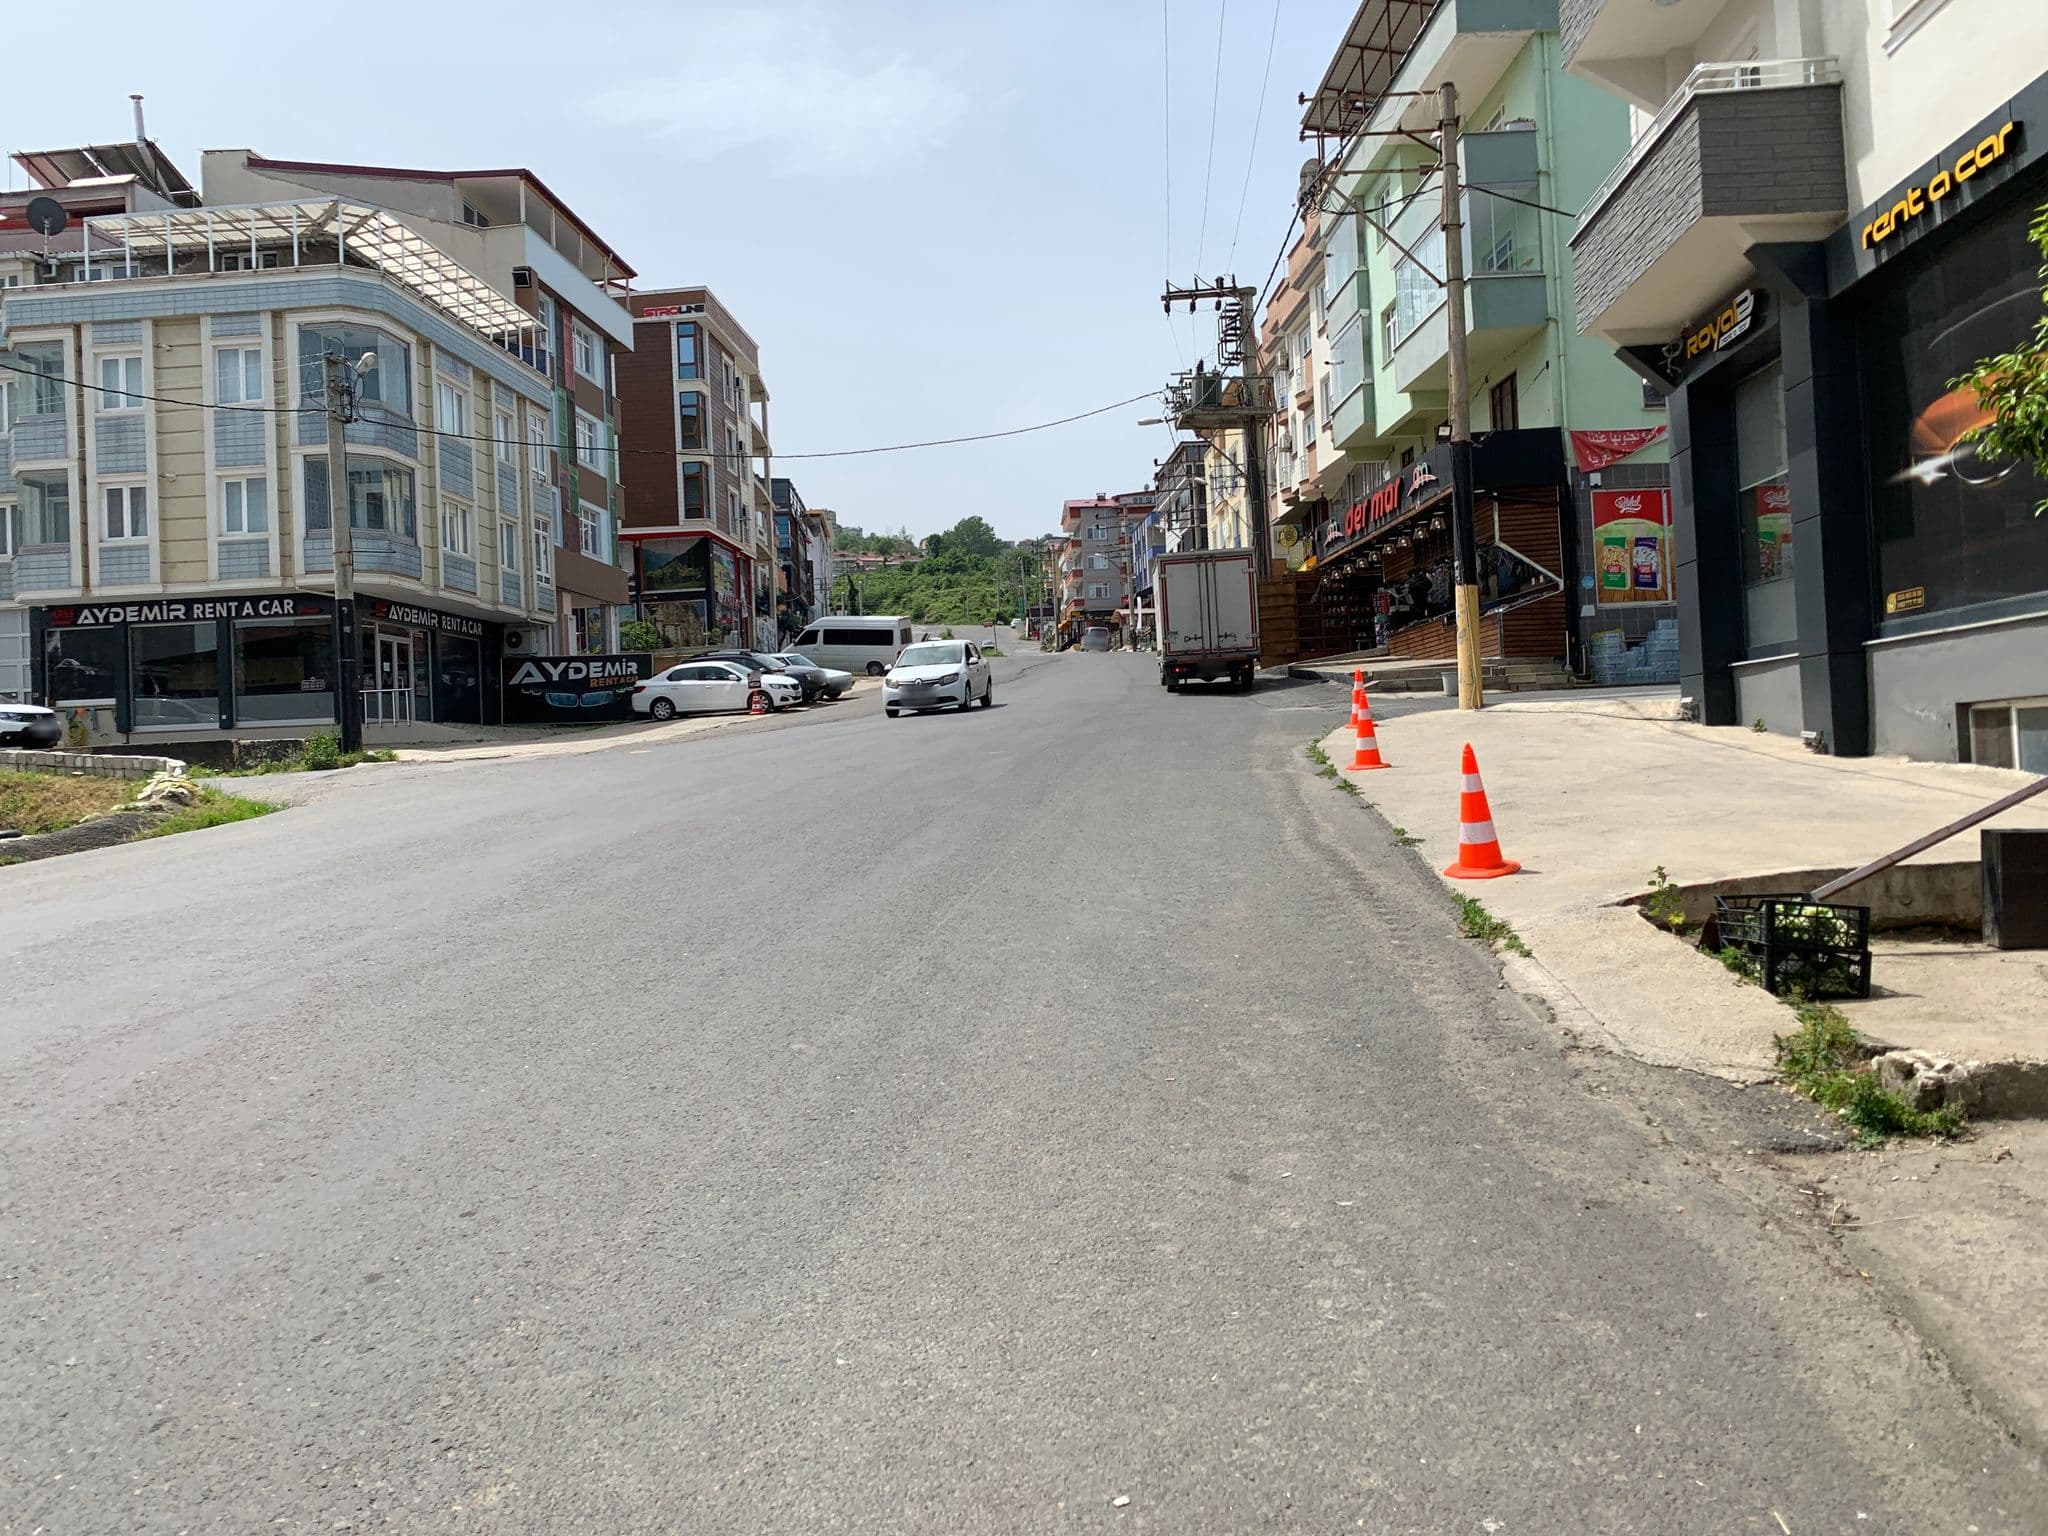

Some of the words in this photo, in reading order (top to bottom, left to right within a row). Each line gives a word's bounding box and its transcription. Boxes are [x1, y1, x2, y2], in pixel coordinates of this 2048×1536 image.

[1862, 186, 1925, 251] rent
[1928, 170, 1951, 202] a
[1954, 120, 2014, 184] car
[1345, 500, 1369, 536] der
[1371, 477, 1403, 521] mar
[193, 602, 239, 619] RENT
[242, 603, 255, 617] A
[259, 599, 295, 616] CAR
[441, 615, 461, 633] RENT
[461, 620, 468, 634] A
[468, 621, 484, 636] CAR
[590, 676, 618, 688] RENT
